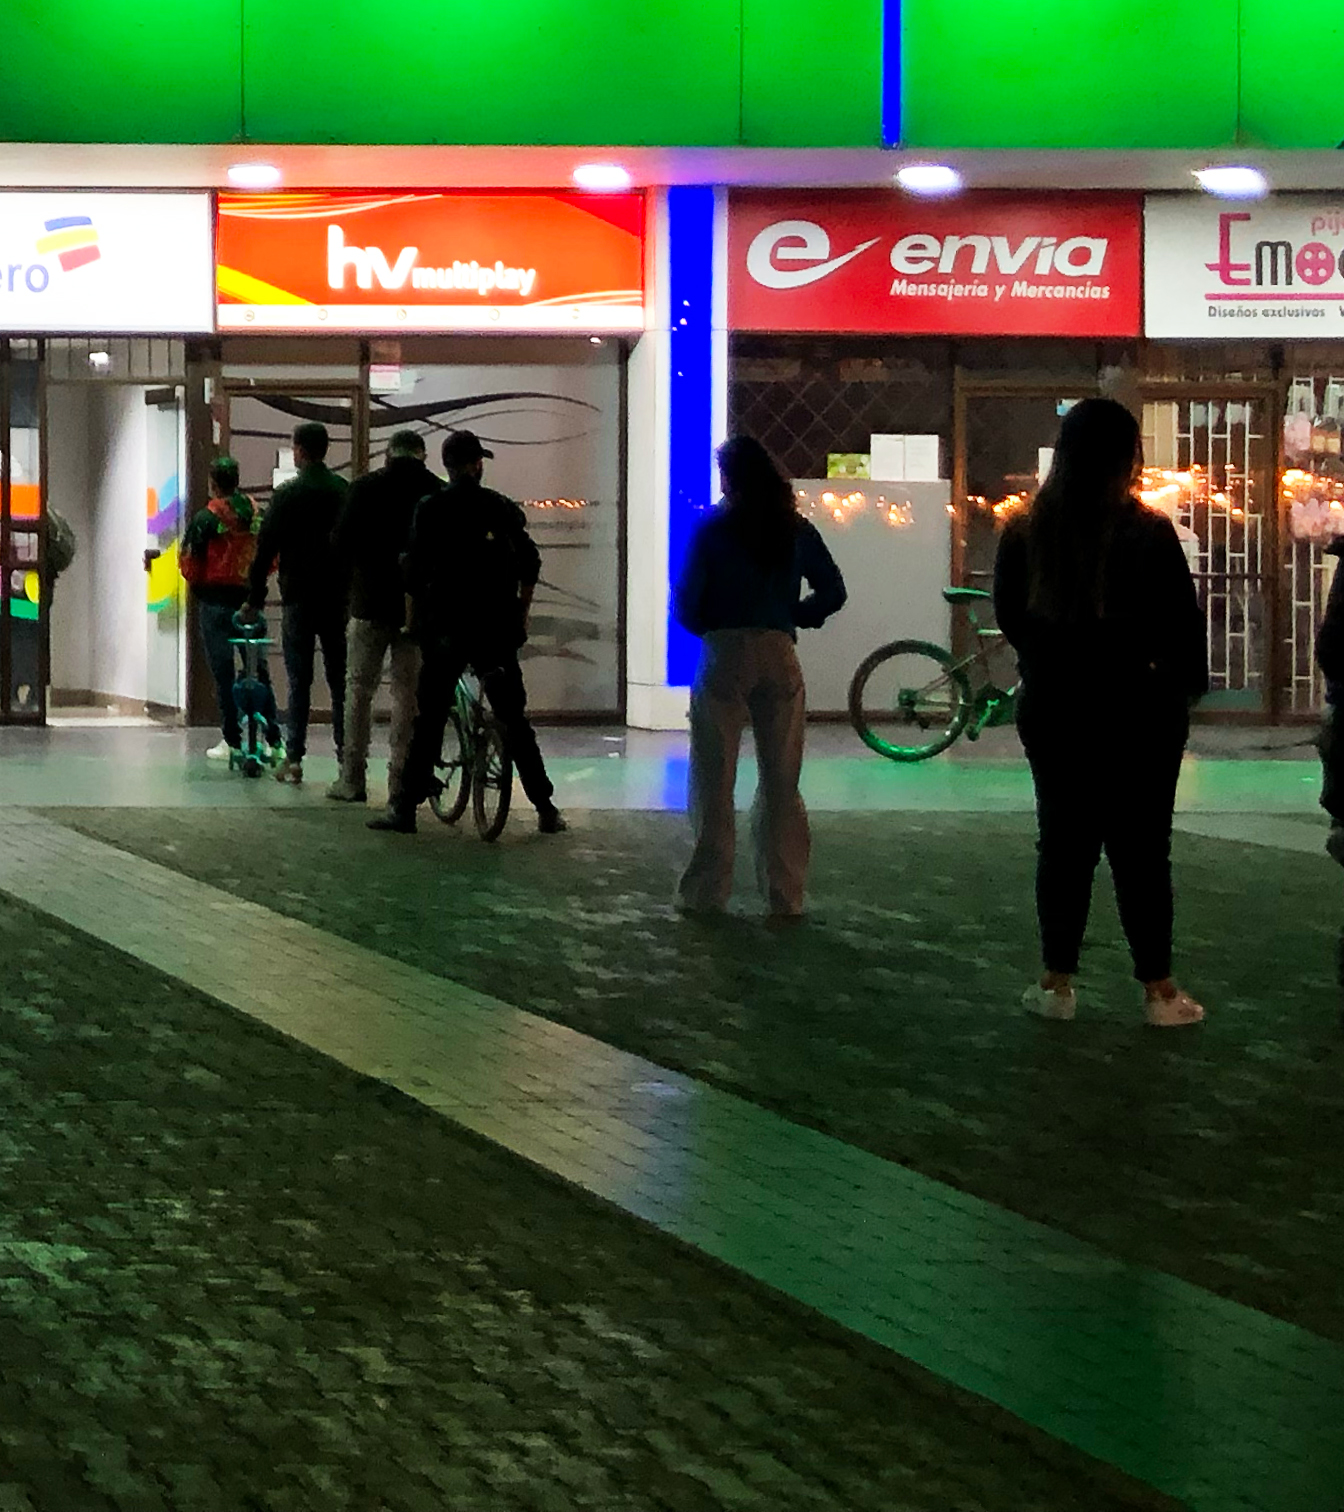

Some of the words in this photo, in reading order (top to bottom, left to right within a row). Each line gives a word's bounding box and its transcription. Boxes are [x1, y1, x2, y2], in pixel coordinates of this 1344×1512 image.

[994, 284, 1006, 302] y
[1208, 305, 1258, 318] Diseños
[1261, 306, 1325, 318] exclusivos
